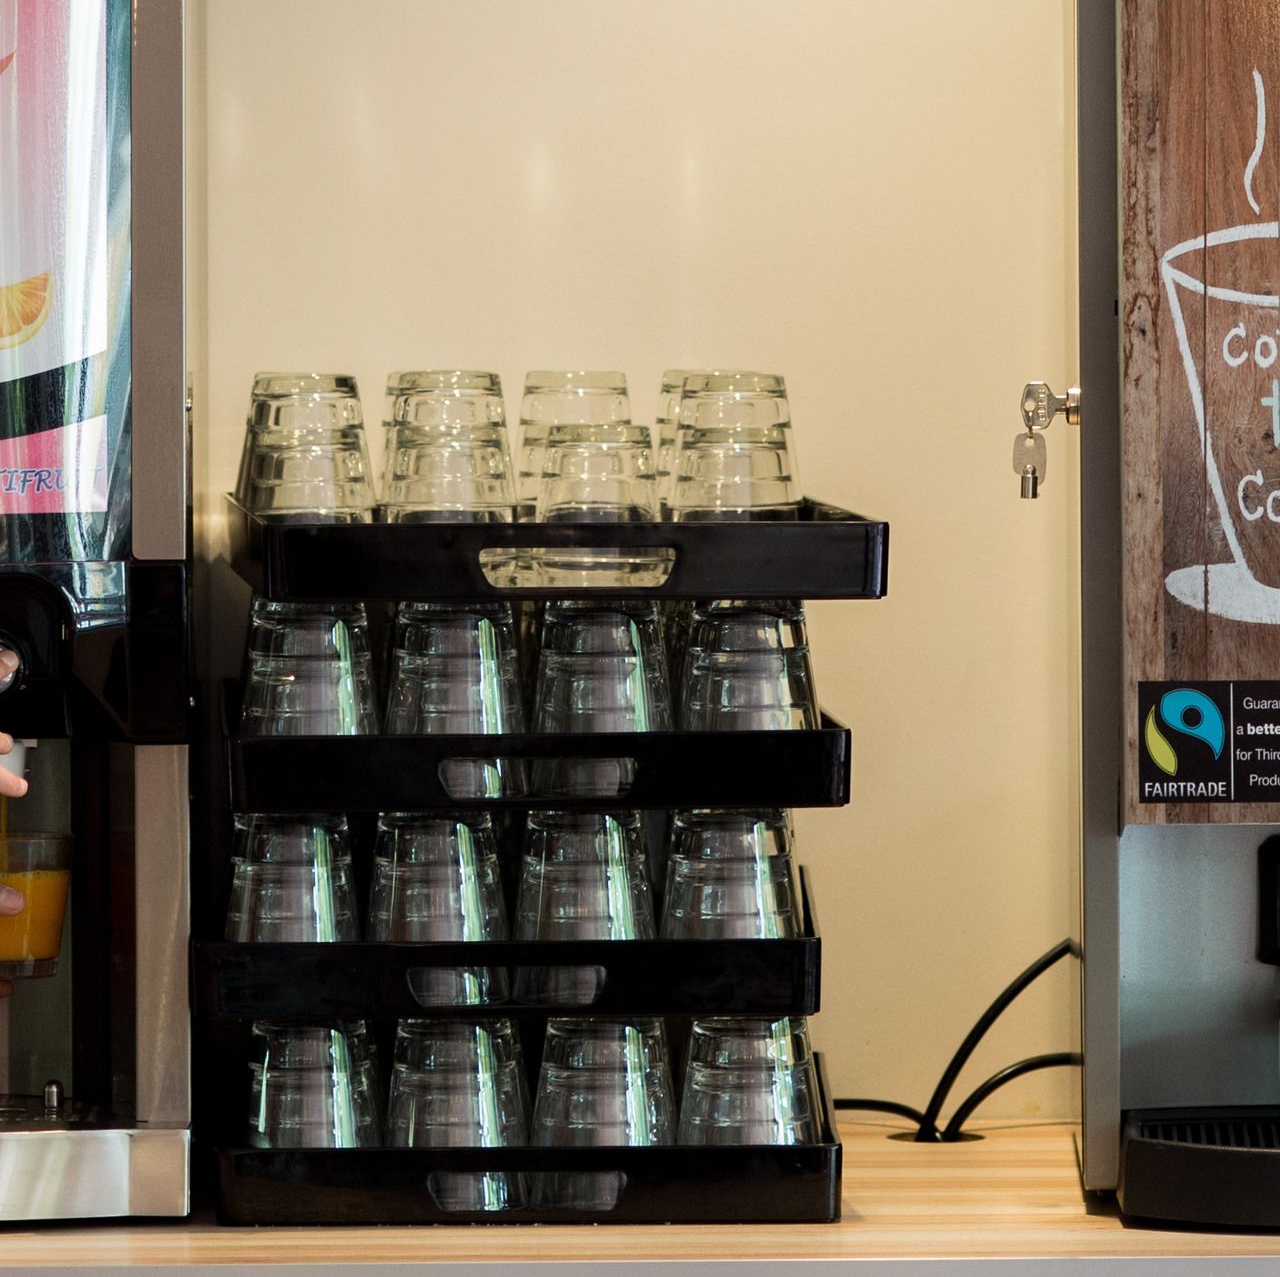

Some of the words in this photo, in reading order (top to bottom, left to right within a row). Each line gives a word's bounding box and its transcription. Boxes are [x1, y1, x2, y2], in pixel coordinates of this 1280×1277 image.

[1236, 725, 1244, 736] a
[1236, 748, 1252, 762] for
[1144, 782, 1227, 798] FAIRTRADE
